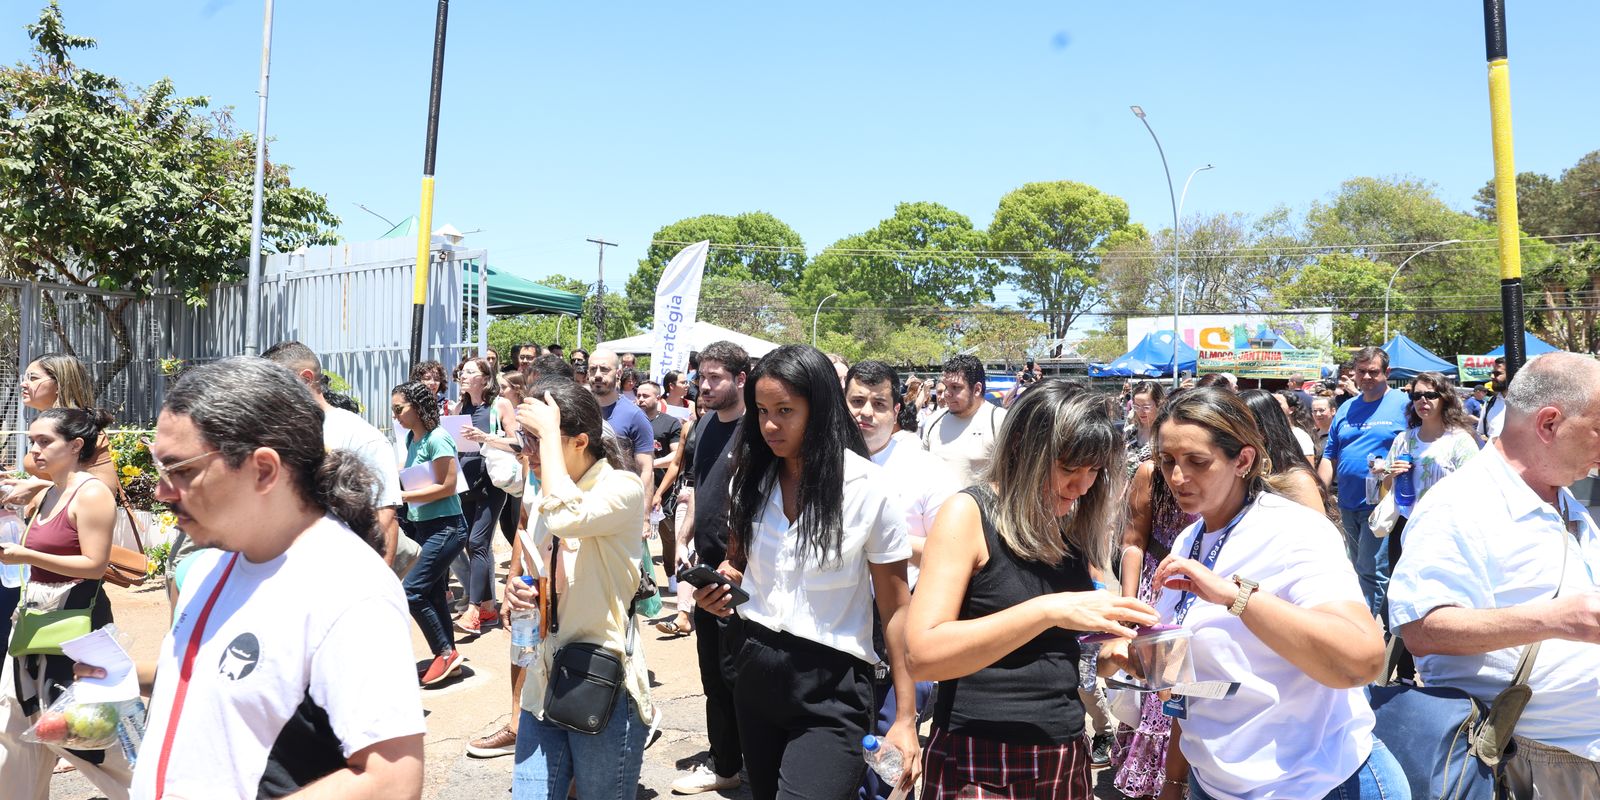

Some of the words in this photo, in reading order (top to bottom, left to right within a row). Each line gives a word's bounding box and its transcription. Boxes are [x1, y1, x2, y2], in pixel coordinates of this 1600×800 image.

[1238, 351, 1282, 361] JANTINHA
[1464, 357, 1496, 368] ALM
[1192, 540, 1200, 556] FGV
[1208, 545, 1220, 562] FGV
